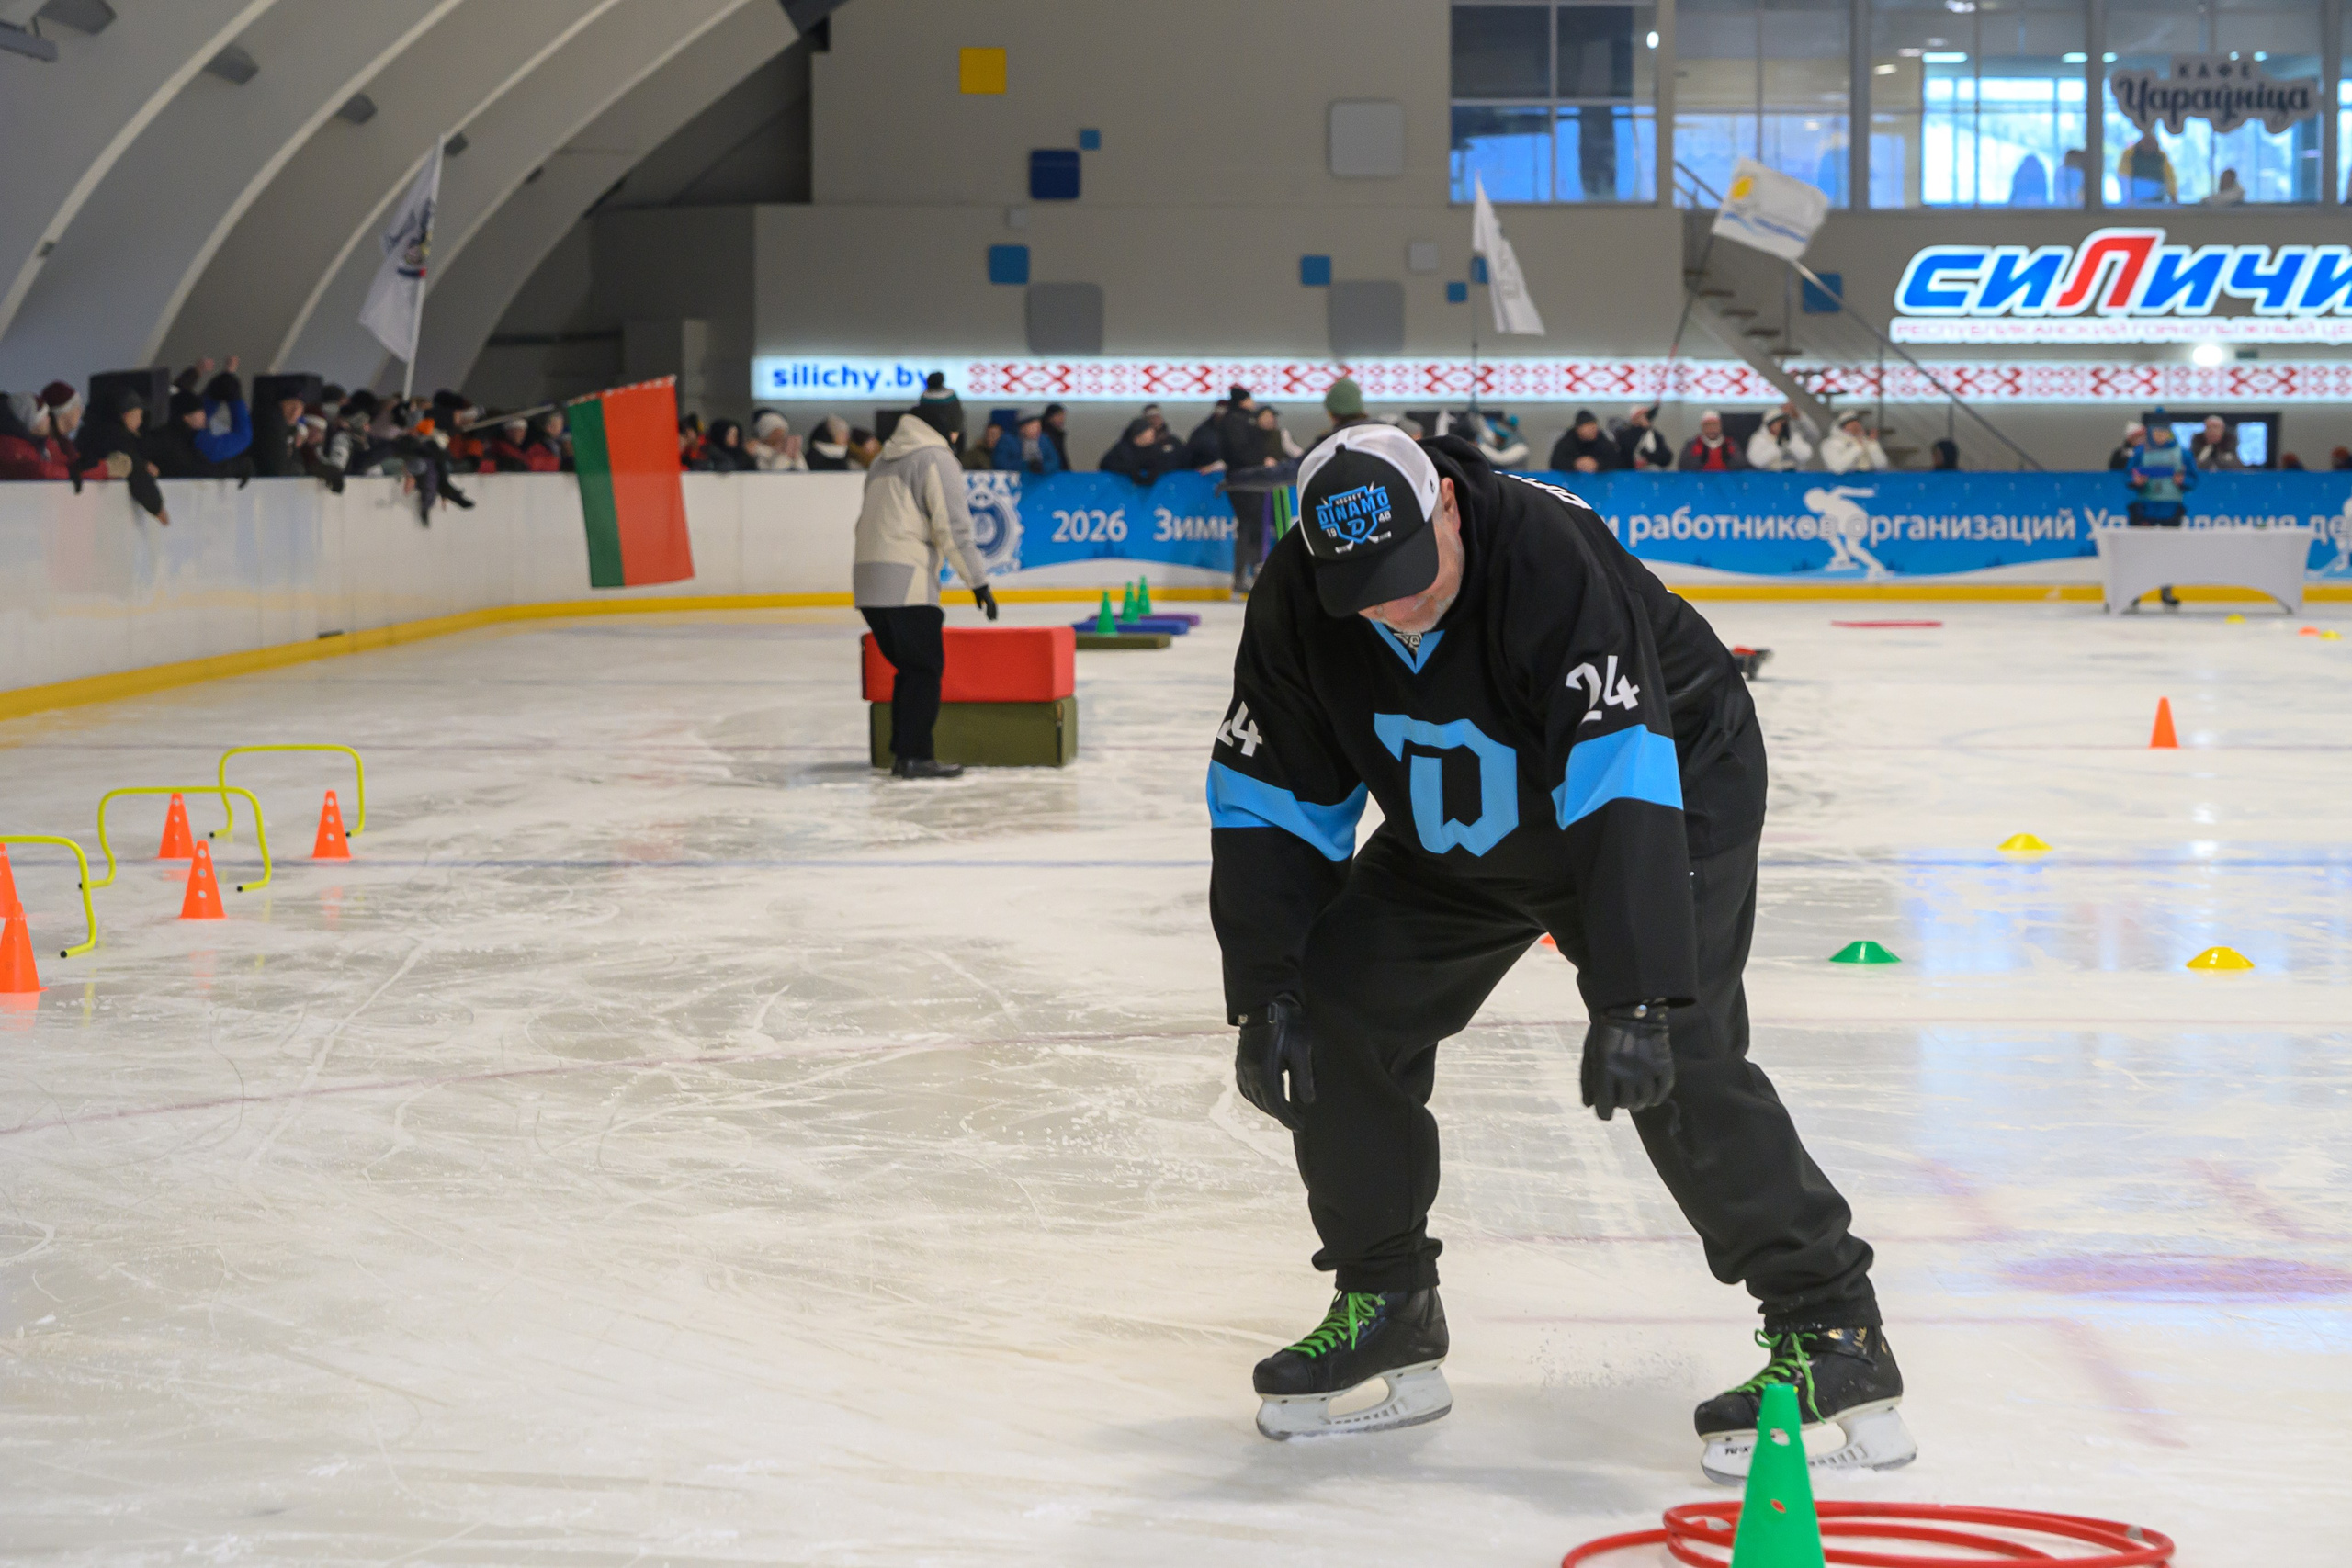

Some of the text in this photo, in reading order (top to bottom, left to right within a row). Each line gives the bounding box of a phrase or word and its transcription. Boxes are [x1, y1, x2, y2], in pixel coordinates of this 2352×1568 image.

[1317, 491, 1389, 525] DINAMO
[1378, 510, 1392, 523] 48
[1052, 509, 1128, 542] 2026
[1629, 505, 1840, 548] работников
[1845, 508, 2076, 547] организаций
[1326, 527, 1338, 538] 19
[1565, 655, 1641, 724] 24
